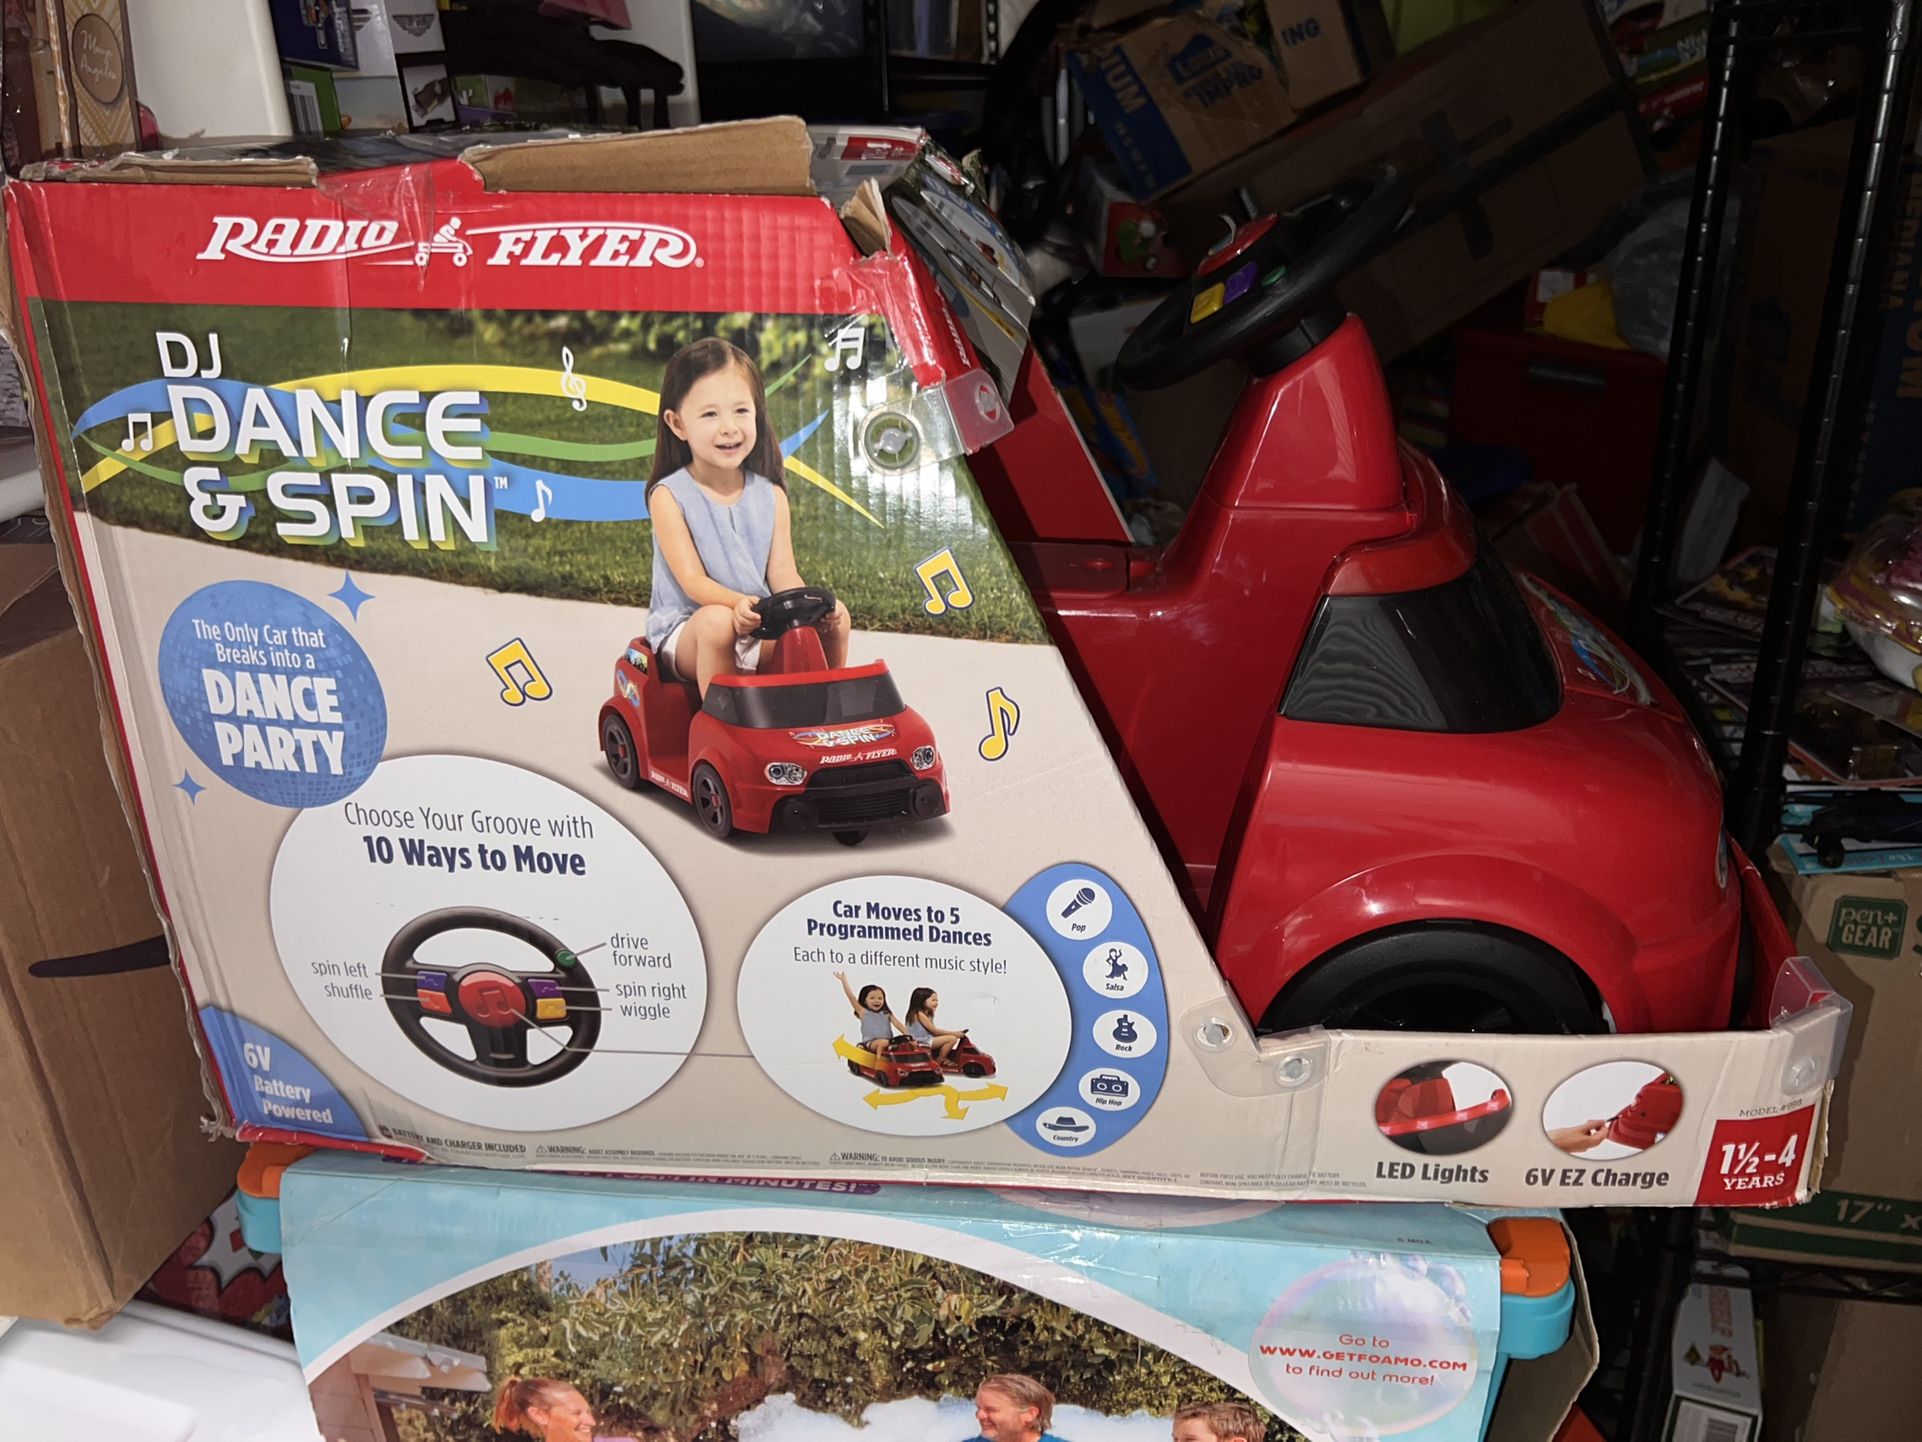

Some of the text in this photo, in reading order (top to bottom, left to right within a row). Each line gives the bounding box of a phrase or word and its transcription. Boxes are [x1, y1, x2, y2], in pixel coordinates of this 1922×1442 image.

[196, 216, 699, 268] RADIO FLYER
[155, 331, 223, 380] DJ
[167, 384, 488, 465] DANCE
[184, 466, 251, 538] &
[266, 471, 493, 547] SPIN
[192, 619, 326, 648] The Only Car that
[215, 643, 316, 669] Breaks into a
[202, 668, 343, 724] DANCE
[214, 721, 345, 775] PARTY
[344, 802, 594, 839] Choose Your Groove with
[362, 835, 587, 876] 10 Ways to Move
[832, 900, 960, 925] Car Moves to 5
[807, 918, 992, 947] Programmed Dances
[1071, 923, 1086, 933] Pop
[1841, 924, 1893, 949] GEAR
[610, 933, 649, 951] drive
[311, 959, 369, 979] spin left
[612, 950, 673, 970] forward
[794, 946, 1008, 975] Each to a different music style!
[324, 983, 373, 1001] shuffle
[615, 981, 687, 1001] spin right
[1105, 983, 1125, 992] Salsa
[620, 1002, 671, 1020] wiggle
[243, 1042, 271, 1072] 6V
[1115, 1043, 1133, 1053] Rock
[253, 1074, 311, 1104] Battery
[262, 1098, 334, 1125] Powered
[1095, 1097, 1123, 1107] Hip Hop
[1739, 1106, 1779, 1117] MODEL
[426, 1137, 443, 1147] AND
[444, 1138, 483, 1151] CHARGER
[485, 1143, 527, 1153] INCLUDED
[1053, 1134, 1079, 1143] Country
[1376, 1161, 1489, 1184] LED Lights
[1525, 1168, 1669, 1189] 6V EZ Charge
[1723, 1173, 1785, 1190] YEARS
[1338, 1333, 1390, 1348] Go to
[1259, 1345, 1468, 1371] WWW.GETFOAMO.COM
[1285, 1363, 1435, 1386] to find out more!
